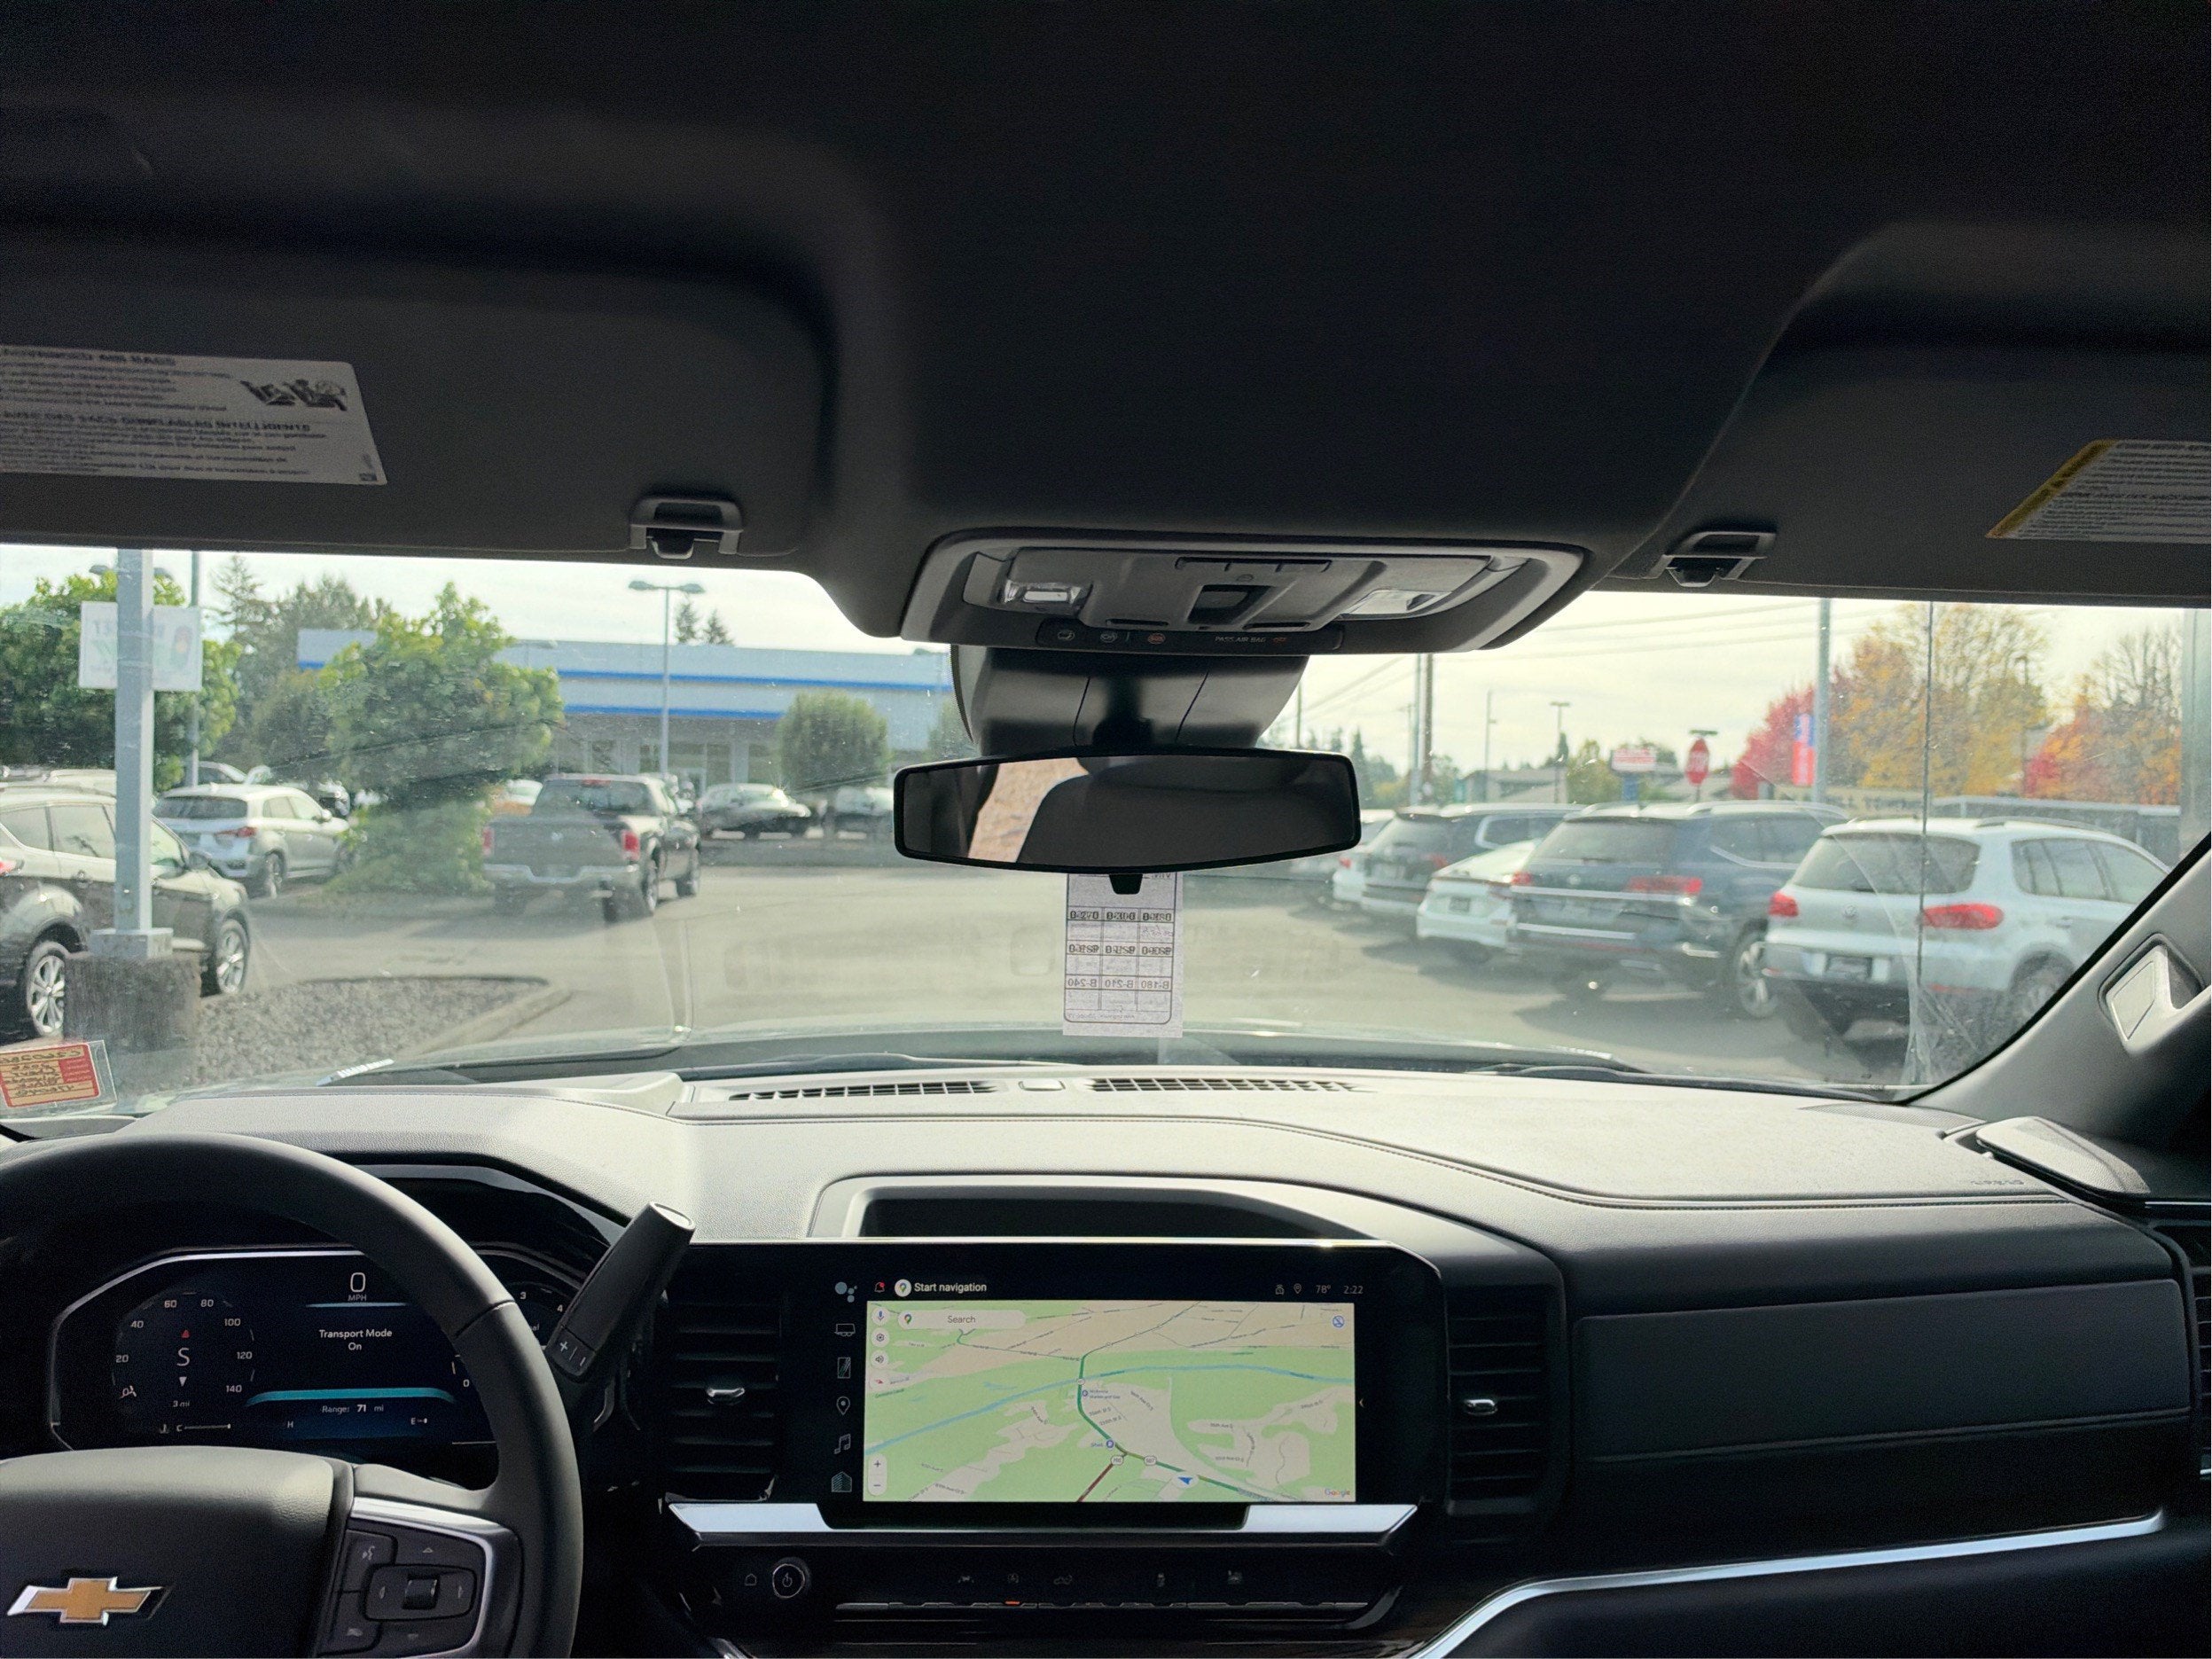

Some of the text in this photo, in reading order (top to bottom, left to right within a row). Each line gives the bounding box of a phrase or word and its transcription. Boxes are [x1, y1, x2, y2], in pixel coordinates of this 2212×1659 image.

[350, 1272, 366, 1293] 0
[914, 1282, 987, 1294] Start navigation
[1343, 1285, 1364, 1295] 2:22
[520, 1291, 527, 1300] 3
[224, 1318, 241, 1326] 100
[947, 1315, 976, 1324] Search
[130, 1320, 144, 1329] 40
[319, 1328, 393, 1340] Transport Mode
[348, 1342, 363, 1350] On
[115, 1354, 129, 1363] 20
[176, 1347, 191, 1366] S
[463, 1379, 470, 1388] 0
[225, 1384, 242, 1393] 140
[322, 1404, 384, 1414] Range: 71 mi
[1324, 1488, 1350, 1499] Google
